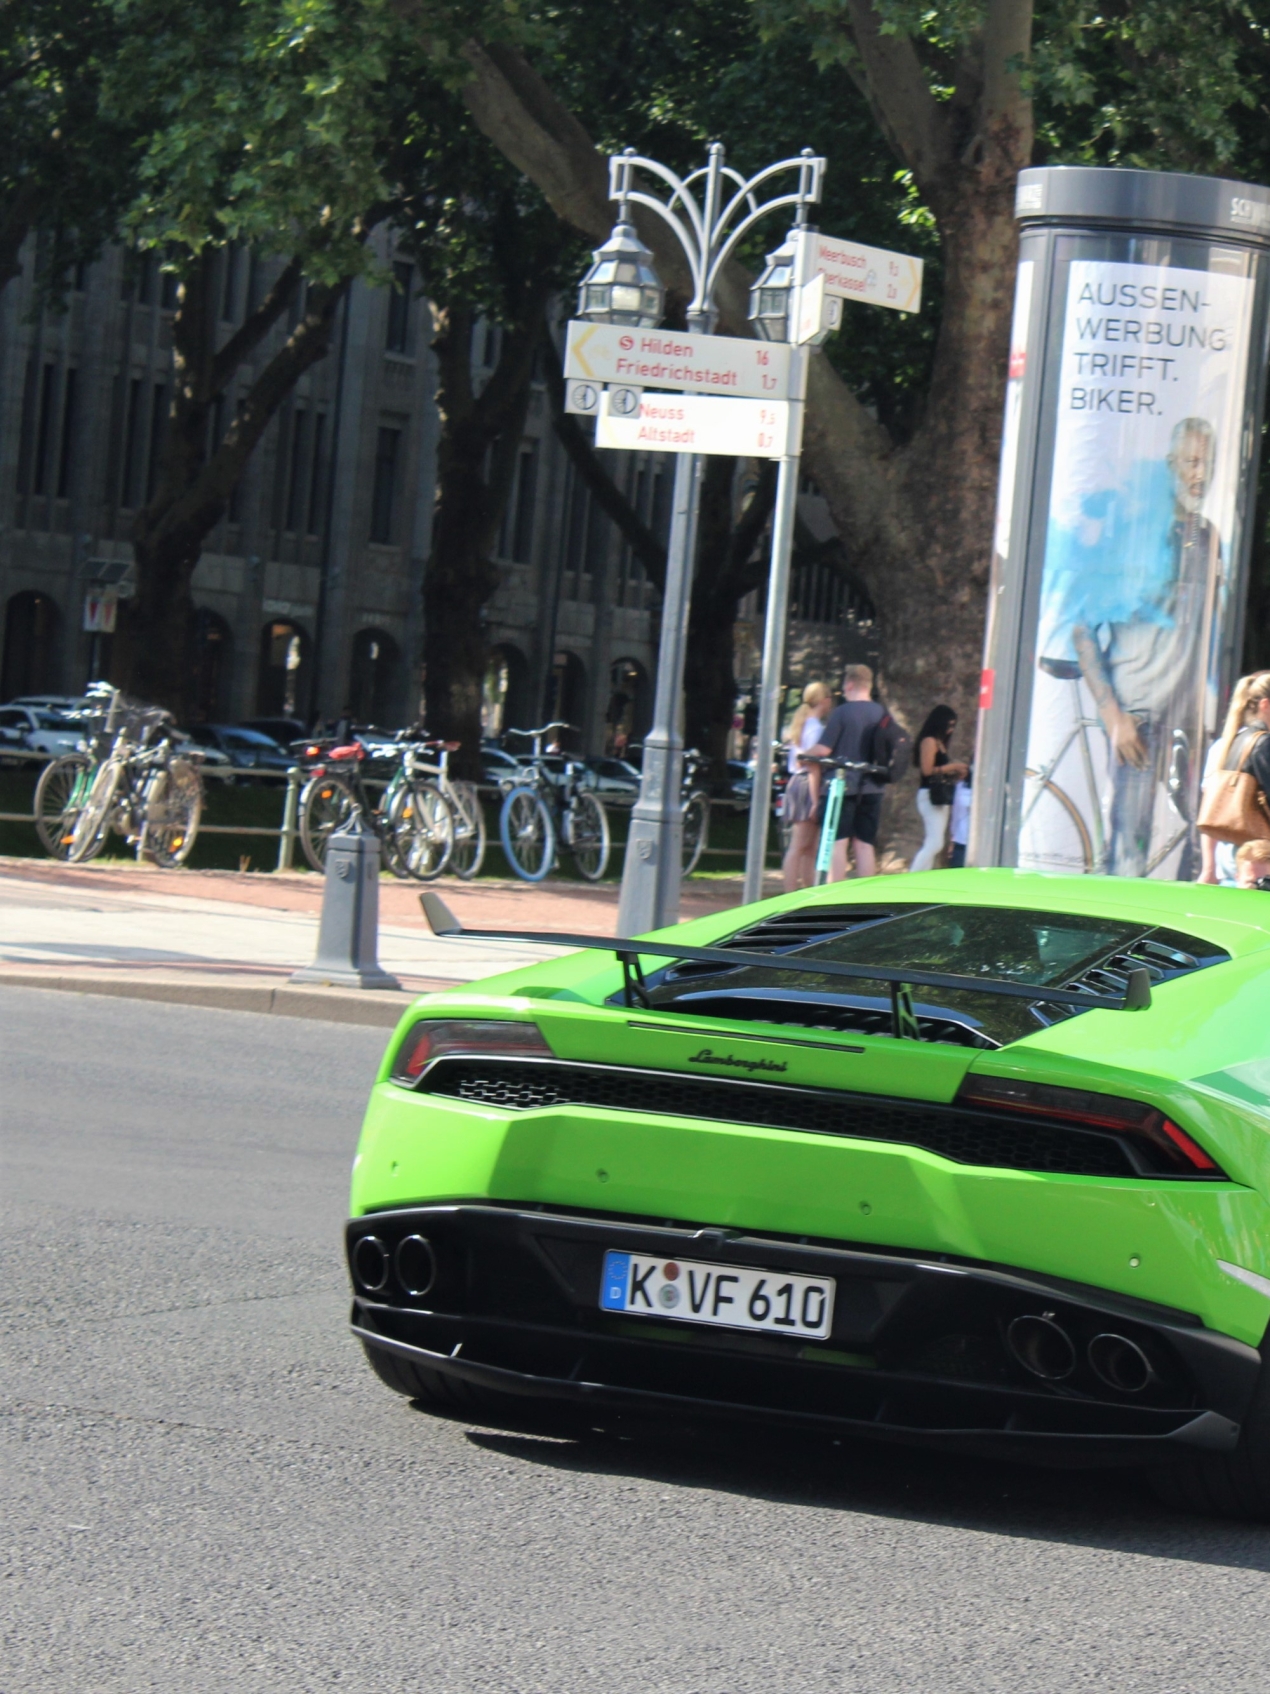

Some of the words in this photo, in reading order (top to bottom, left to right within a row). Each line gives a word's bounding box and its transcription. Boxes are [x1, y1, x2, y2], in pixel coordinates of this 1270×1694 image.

[819, 245, 867, 269] Meerbusch
[1077, 282, 1210, 313] AUSSEN-
[1076, 318, 1227, 351] WERBUNG
[640, 337, 694, 358] Hilden
[756, 350, 770, 366] 16
[615, 358, 738, 386] Friedrichstadt
[1074, 352, 1179, 382] TRIFFT.
[639, 403, 685, 420] Neuss
[1070, 387, 1163, 416] BIKER.
[638, 426, 695, 443] Altstadt
[688, 1049, 788, 1072] Lamborghini
[629, 1263, 656, 1308] K
[688, 1270, 739, 1316] VF
[749, 1279, 826, 1329] 610
